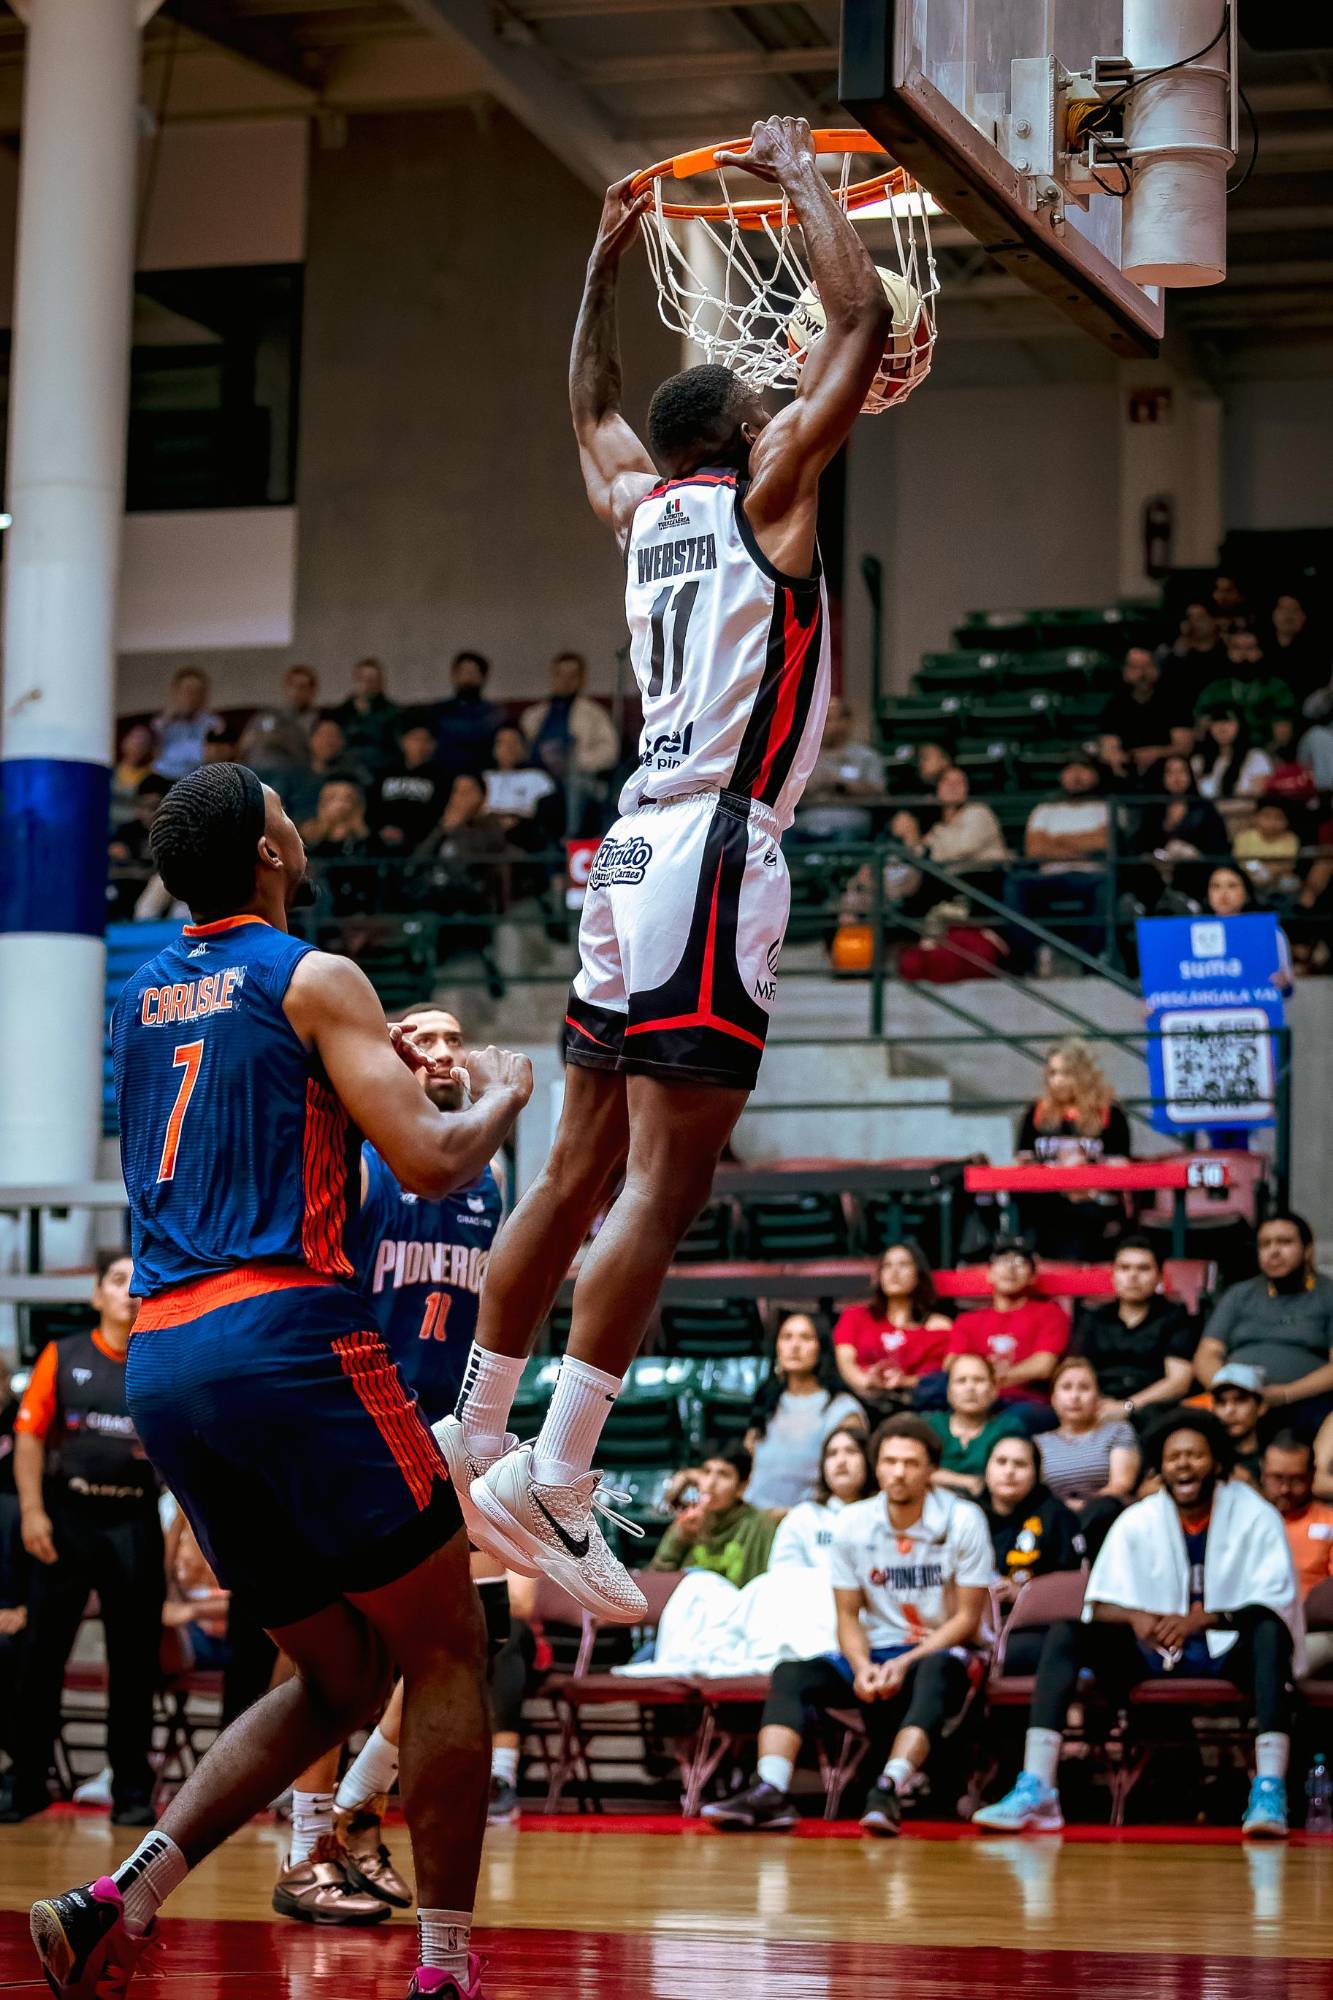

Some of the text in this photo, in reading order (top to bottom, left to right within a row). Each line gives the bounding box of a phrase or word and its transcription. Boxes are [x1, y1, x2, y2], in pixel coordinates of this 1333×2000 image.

[637, 533, 717, 584] WEBSTER
[648, 581, 700, 698] 11
[141, 971, 236, 1025] CARLISLE
[156, 1039, 204, 1184] 7
